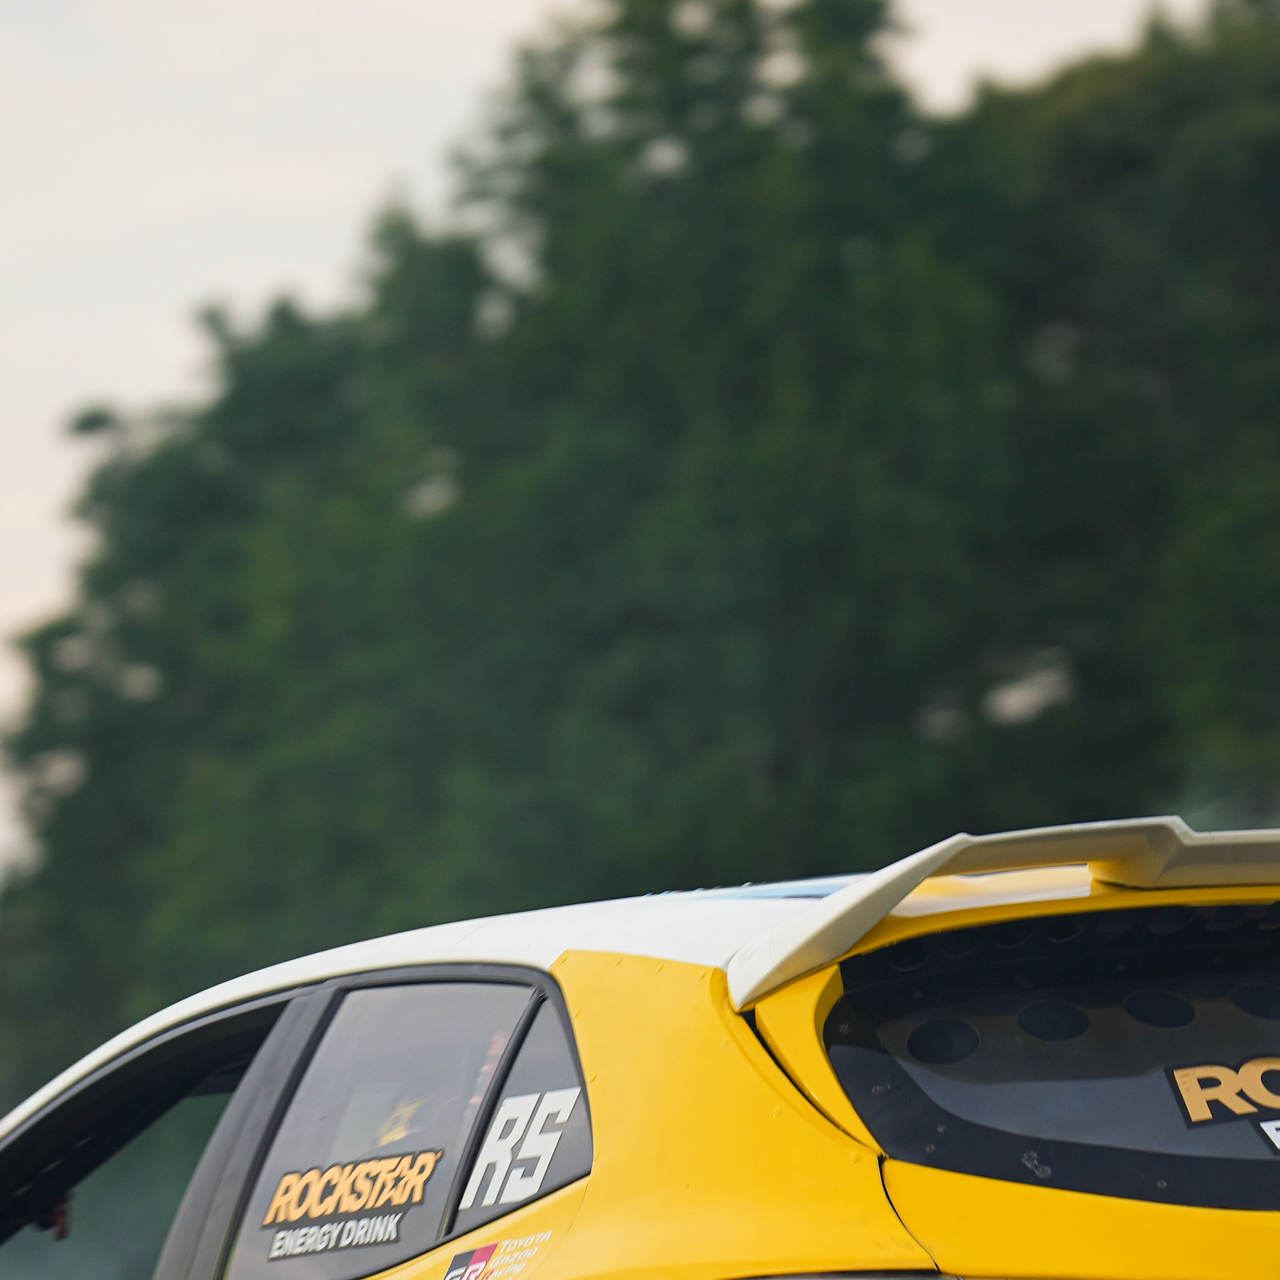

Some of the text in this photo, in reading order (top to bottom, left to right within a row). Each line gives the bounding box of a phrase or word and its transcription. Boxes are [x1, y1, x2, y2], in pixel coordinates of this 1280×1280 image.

[458, 1086, 581, 1210] RS
[263, 1152, 440, 1225] ROCKSTAR
[269, 1213, 404, 1259] ENERGY DRINK
